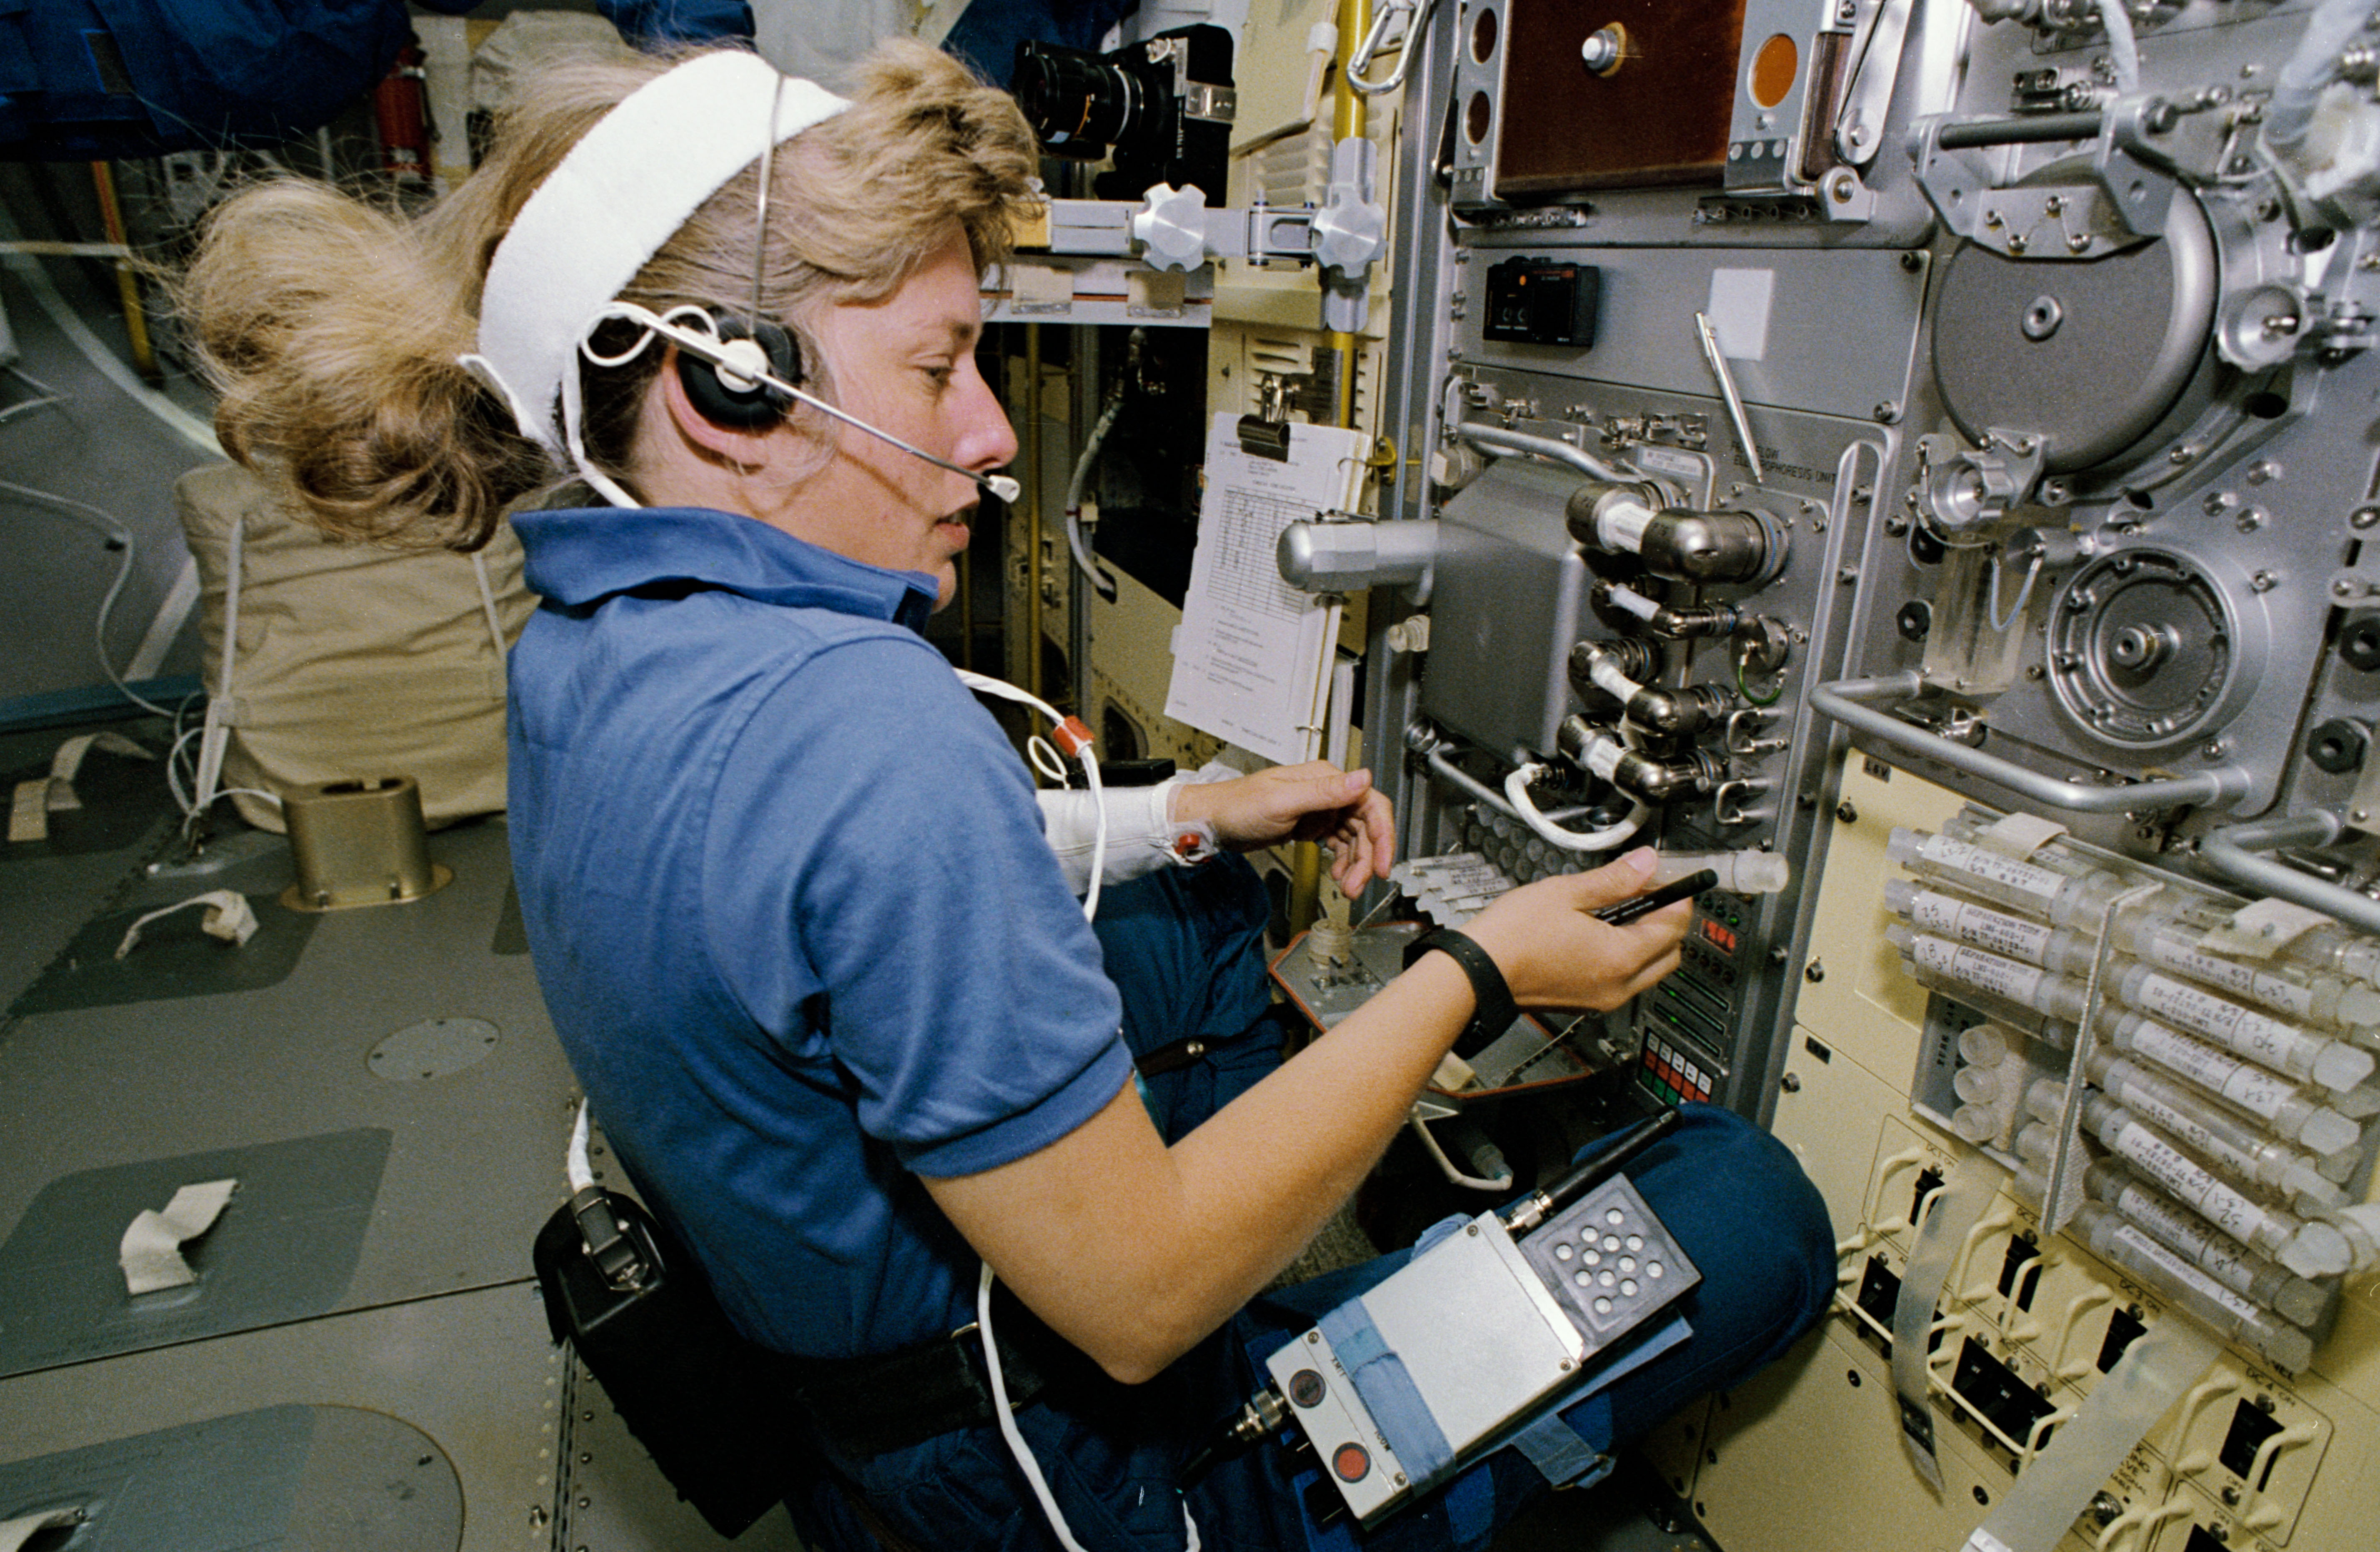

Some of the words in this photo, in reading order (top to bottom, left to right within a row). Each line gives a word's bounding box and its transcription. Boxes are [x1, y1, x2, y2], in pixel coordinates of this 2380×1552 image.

[1734, 454, 1811, 480] ELEROPHORESIS
[1816, 471, 1836, 485] UNIT
[1329, 1356, 1346, 1377] XMIT
[1373, 1429, 1392, 1452] ICOM
